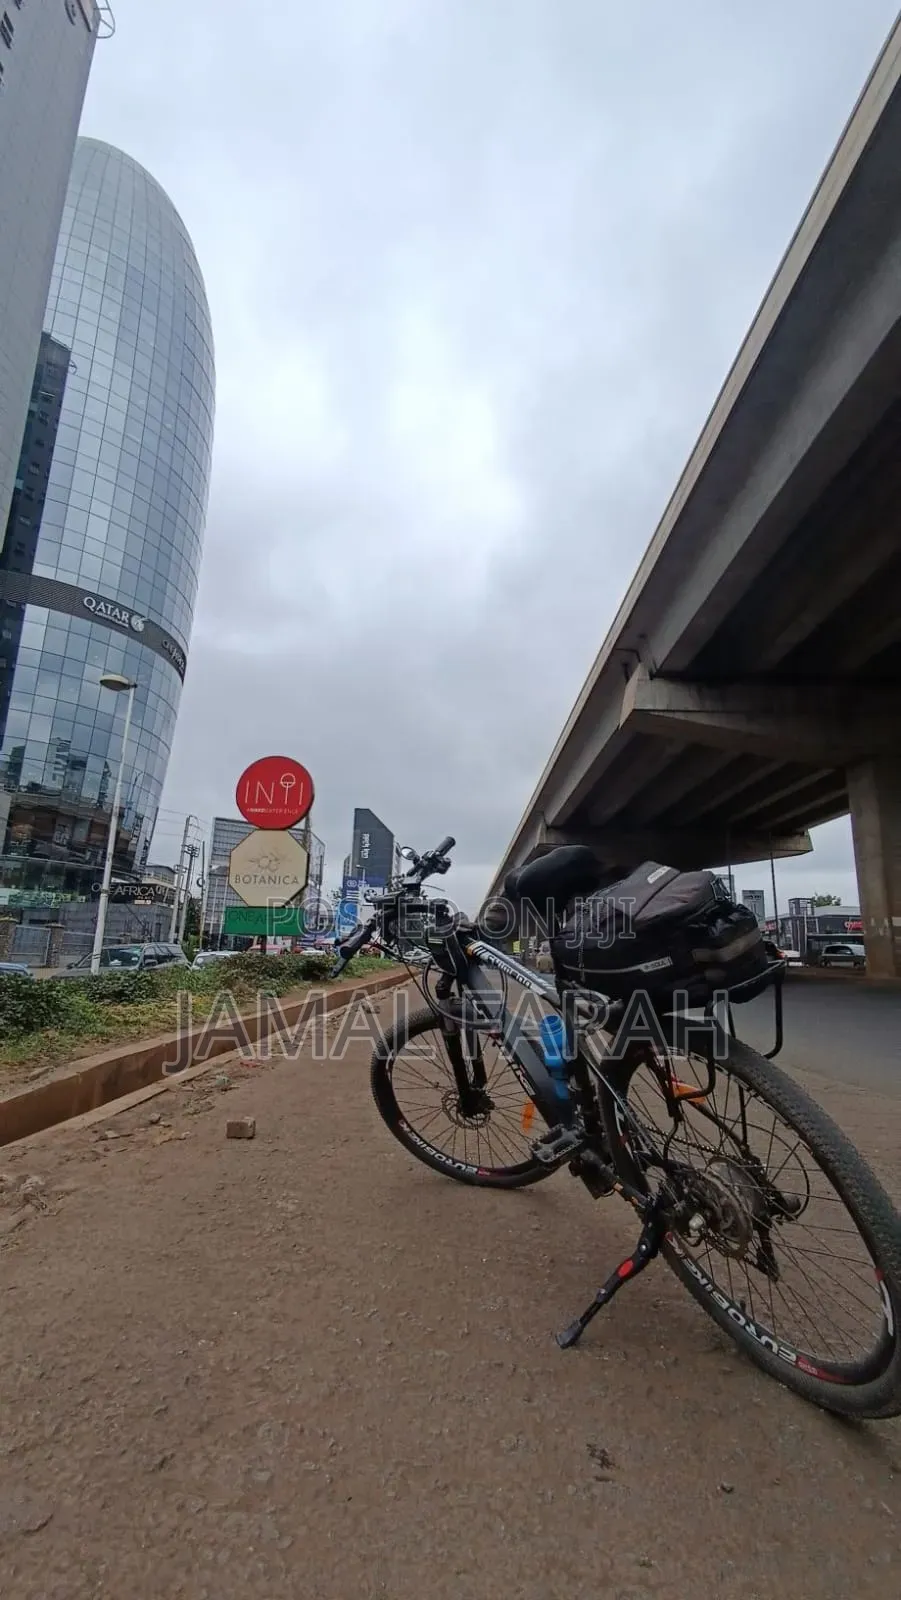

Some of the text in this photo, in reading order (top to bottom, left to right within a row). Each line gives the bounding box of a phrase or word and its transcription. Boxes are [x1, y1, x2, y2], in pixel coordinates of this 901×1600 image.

[83, 596, 130, 624] QATAR
[244, 772, 304, 806] INTI
[91, 882, 115, 895] OE
[114, 885, 155, 897] AFRICA
[234, 874, 299, 885] BOTANICA
